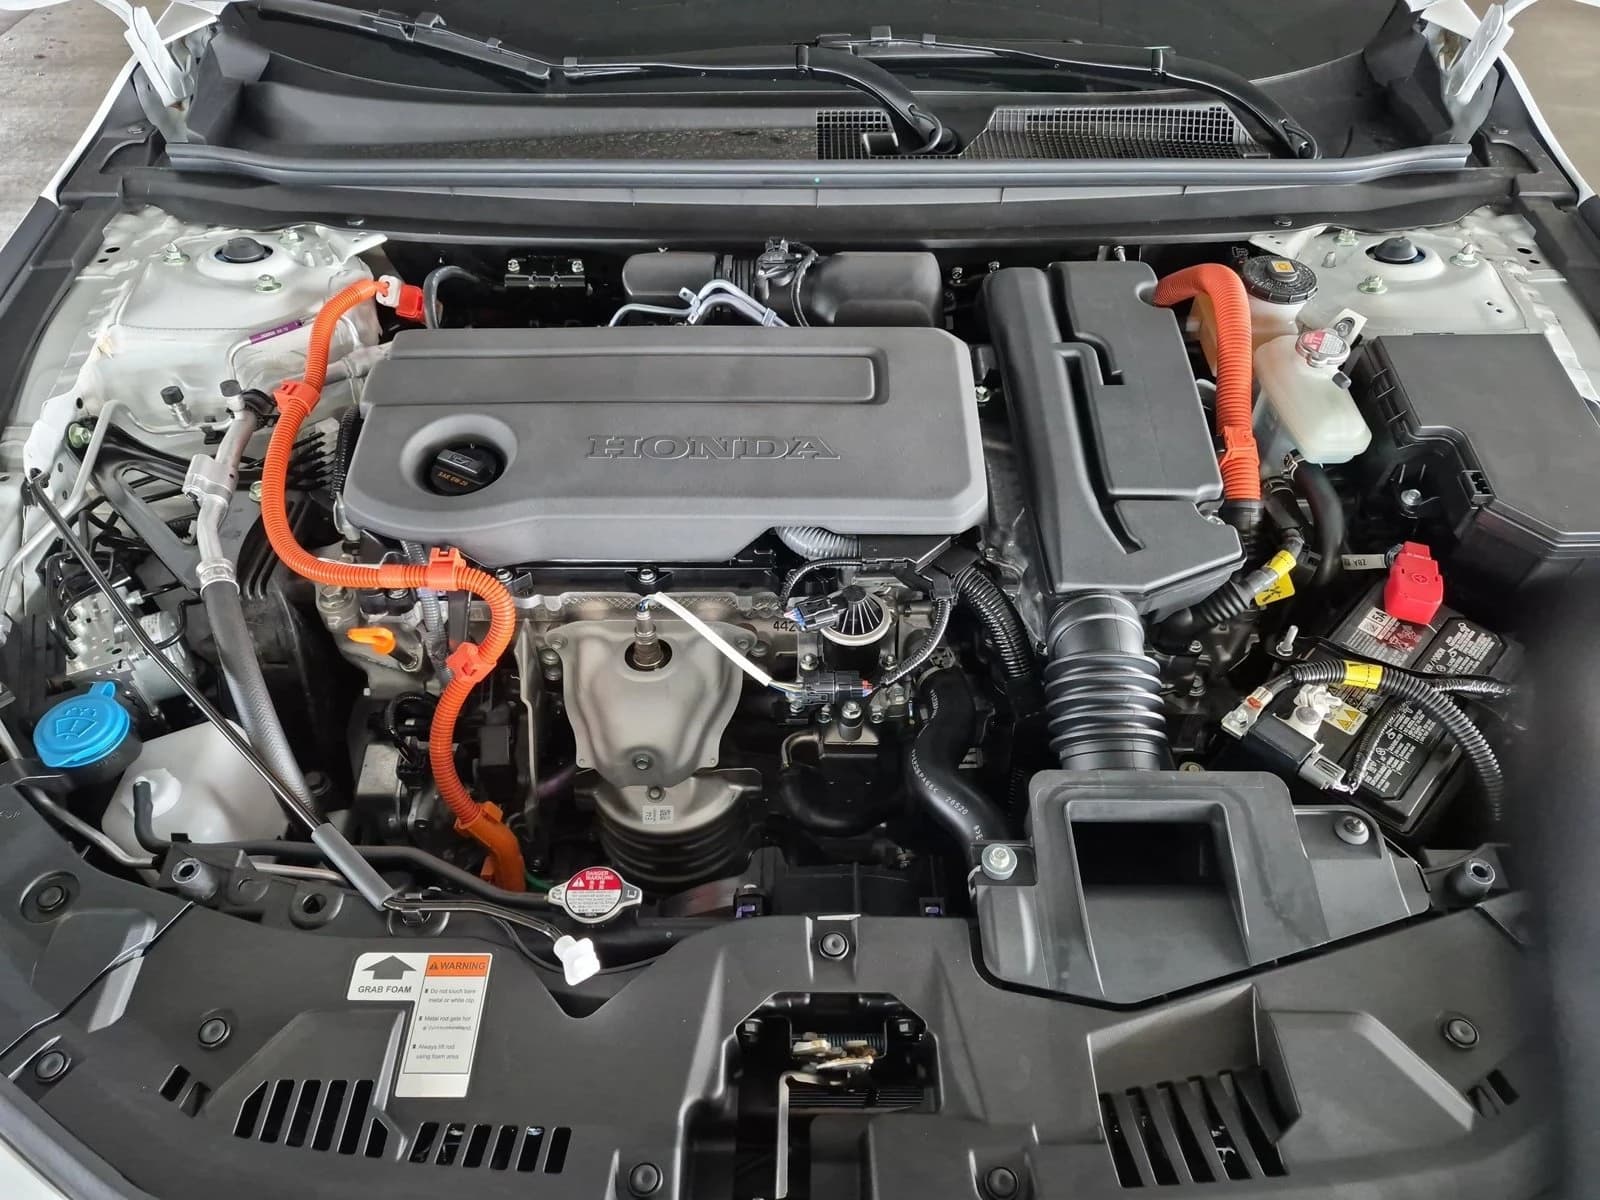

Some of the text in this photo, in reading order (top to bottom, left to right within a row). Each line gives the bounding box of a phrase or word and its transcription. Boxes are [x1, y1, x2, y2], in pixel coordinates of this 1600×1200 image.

[584, 435, 841, 460] HONDA
[440, 961, 486, 970] WARNING
[358, 985, 412, 993] GRAB FOAM
